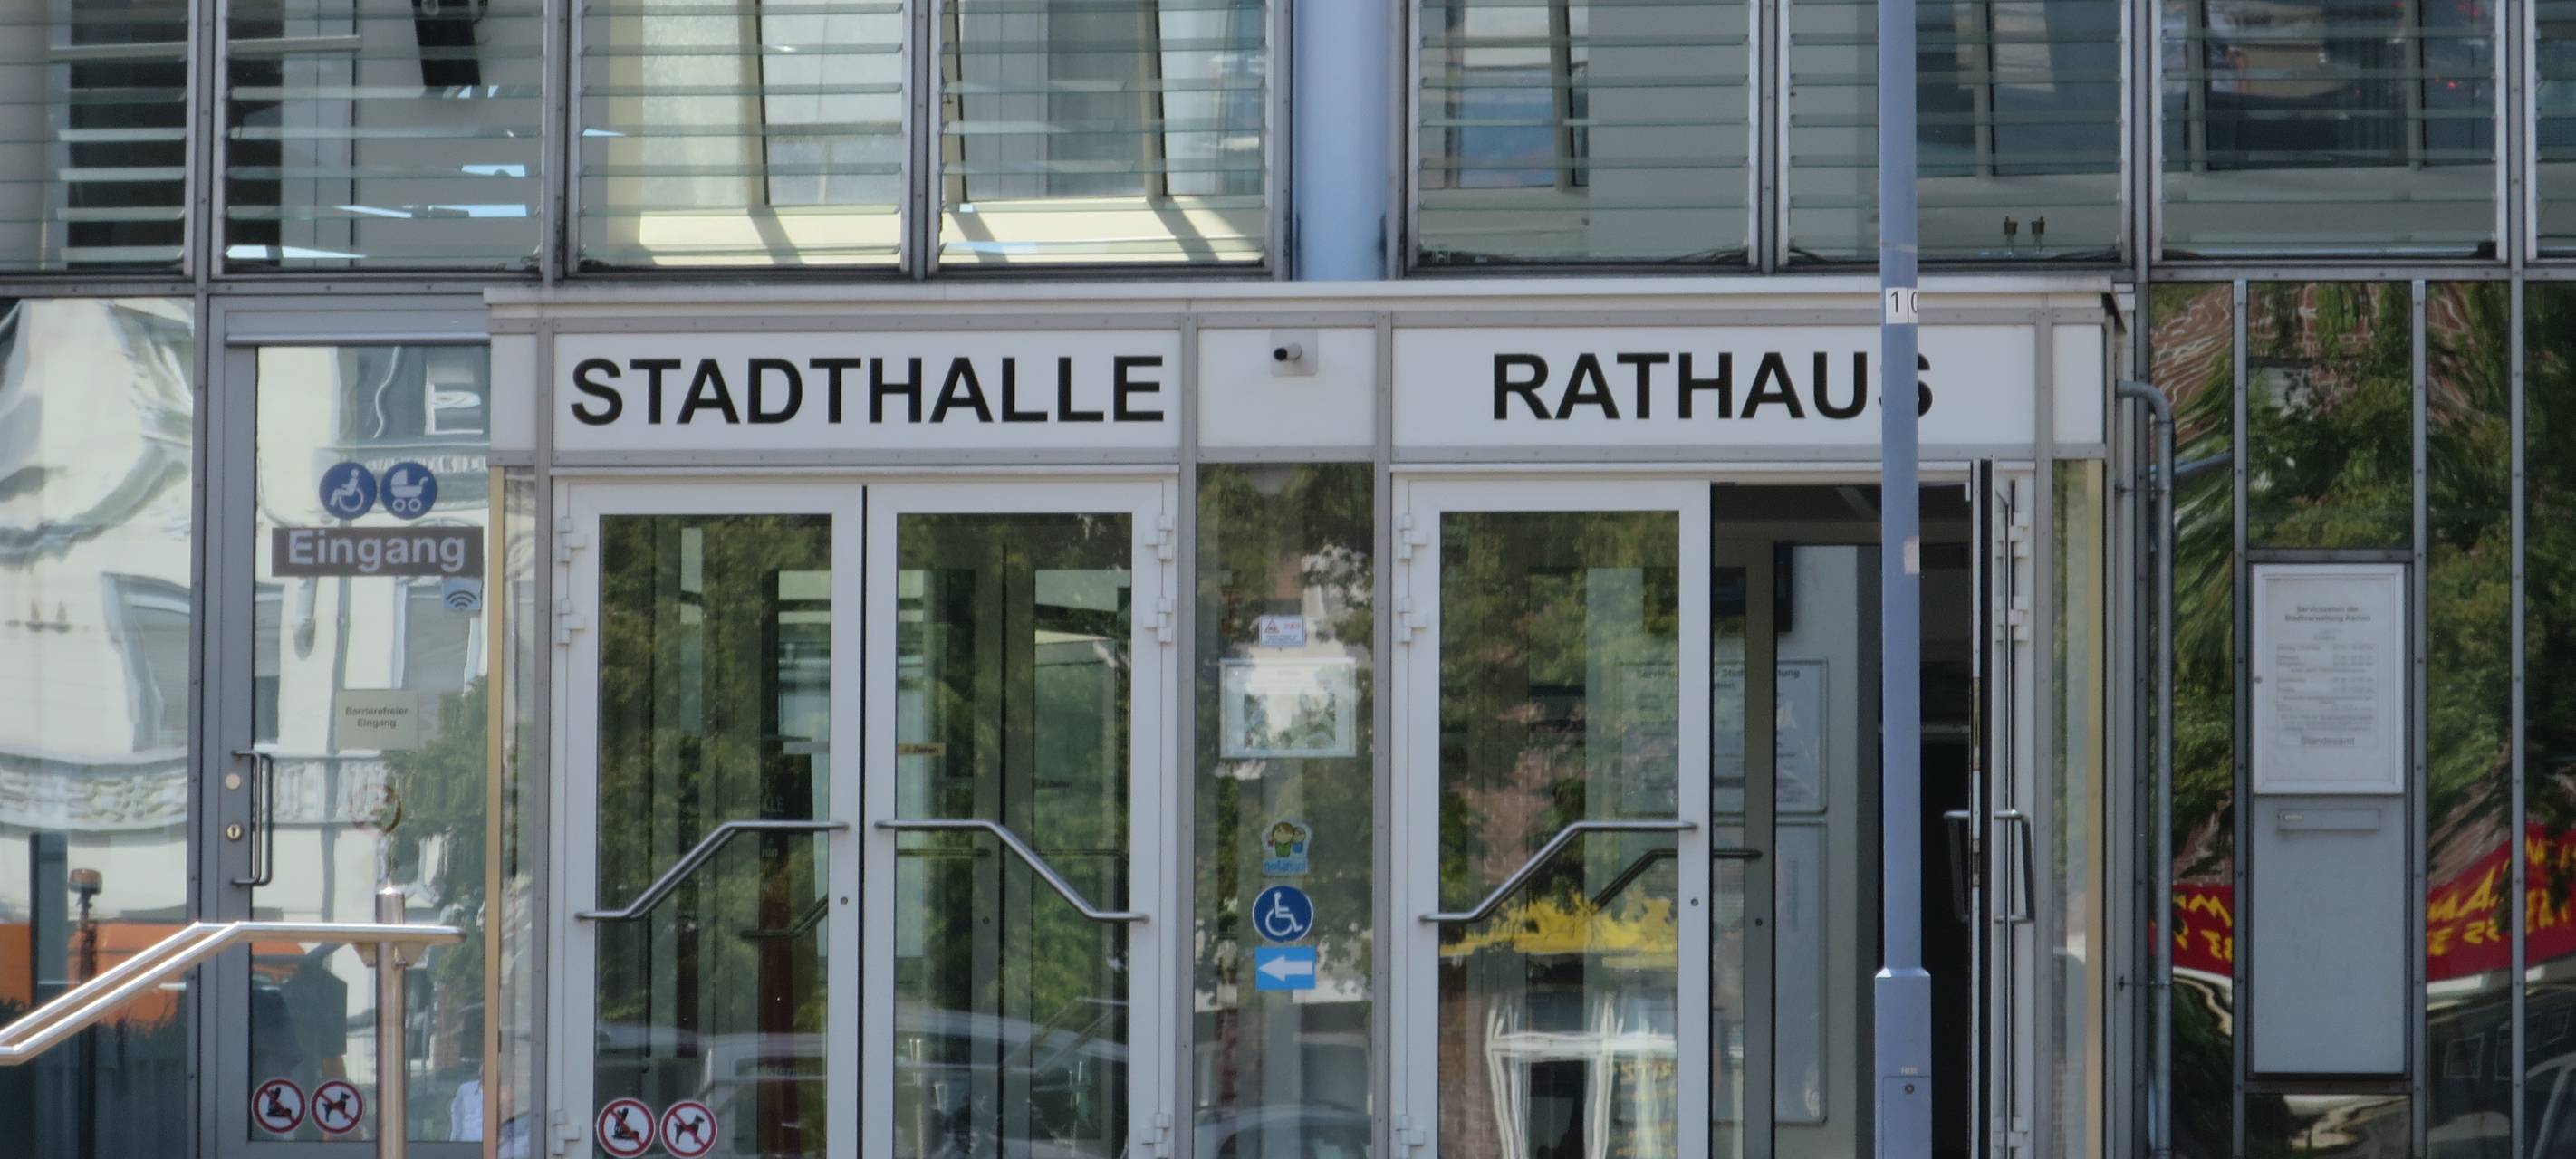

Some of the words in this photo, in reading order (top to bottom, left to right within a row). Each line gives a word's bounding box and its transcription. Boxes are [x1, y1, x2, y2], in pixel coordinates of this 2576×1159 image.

[570, 356, 1165, 426] STADTHALLE
[288, 529, 465, 573] Eingang
[345, 705, 409, 716] Barrierefreier
[357, 717, 397, 730] Eingang
